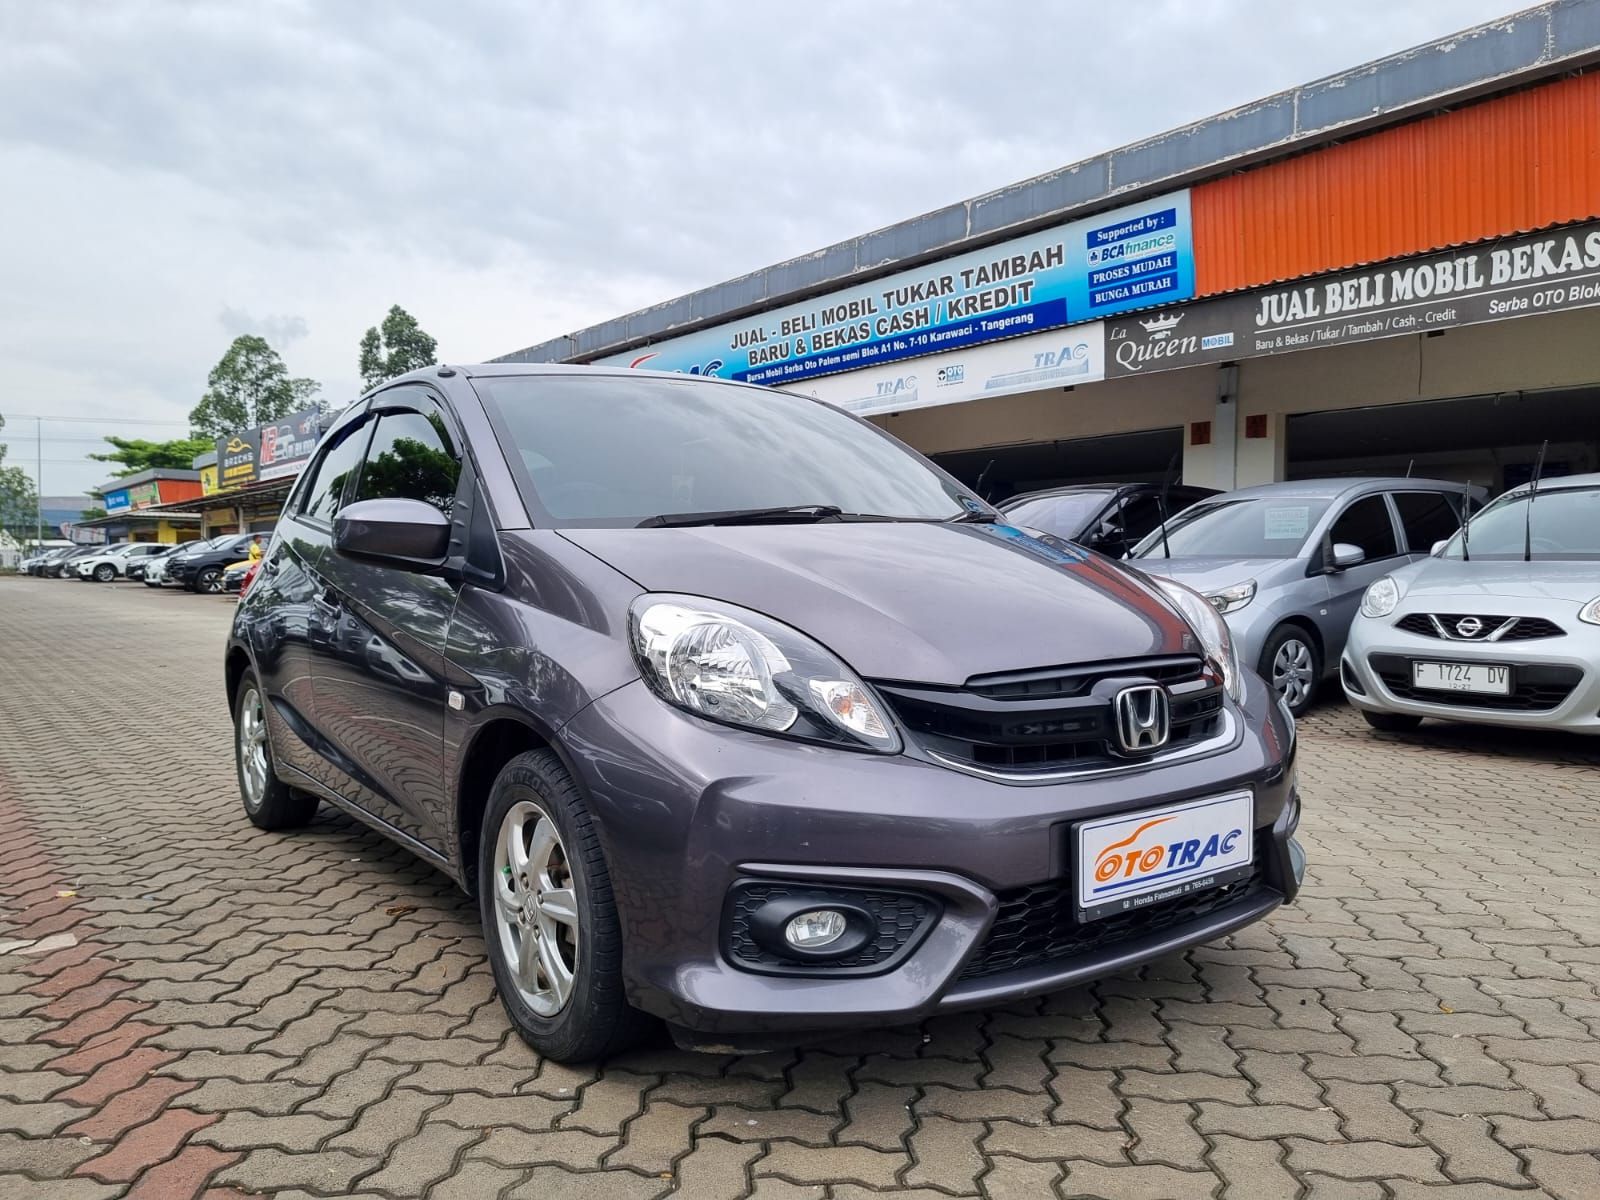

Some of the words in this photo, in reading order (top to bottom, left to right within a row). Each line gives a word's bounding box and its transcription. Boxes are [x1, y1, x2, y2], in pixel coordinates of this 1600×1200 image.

[1097, 221, 1144, 241] Supported
[1146, 216, 1158, 229] by
[1093, 266, 1130, 284] PROSES
[1132, 256, 1172, 275] MUDAH
[1255, 287, 1320, 326] JUAL
[1325, 273, 1385, 315] BELI
[1390, 255, 1484, 303] MOBIL
[1490, 231, 1600, 286] BEKAS
[731, 327, 768, 349] JUAL
[781, 313, 816, 337] BELI
[821, 298, 878, 326] MOBIL
[883, 275, 954, 309] TUKAR
[960, 244, 1064, 289] TAMBAH
[1095, 287, 1130, 304] BUNGA
[1132, 277, 1172, 296] MURAH
[1488, 297, 1529, 315] Serba
[1532, 288, 1565, 307] OTO
[749, 342, 789, 366] BARU
[795, 338, 807, 355] &
[812, 322, 870, 352] BEKAS
[876, 306, 929, 336] CASH
[935, 303, 941, 323] /
[948, 280, 1034, 320] KREDIT
[1110, 327, 1127, 341] La
[1255, 339, 1274, 351] Baru
[1275, 337, 1284, 348] &
[1285, 333, 1309, 346] Bekas
[1316, 325, 1340, 341] Tukar
[1348, 320, 1384, 335] Tambah
[1392, 313, 1416, 328] Cash
[1425, 308, 1457, 323] Credit
[765, 366, 784, 379] Mobil
[784, 362, 803, 375] Serba
[804, 358, 818, 370] Oto
[818, 355, 841, 368] Palem
[842, 352, 860, 362] semi
[861, 345, 879, 358] Blok
[881, 342, 892, 354] A1
[894, 339, 908, 350] No.
[909, 334, 928, 348] 7-10
[930, 322, 973, 345] Karawaci
[980, 313, 1034, 332] Tangerang
[1033, 343, 1089, 368] TRAC
[1115, 335, 1198, 371] Queen
[1202, 335, 1233, 348] MOBIL
[947, 365, 963, 376] OTO
[876, 375, 918, 395] TRAC
[1439, 664, 1472, 682] 1724
[1487, 666, 1506, 684] DV
[1095, 829, 1242, 882] OTOTRAC
[1134, 895, 1154, 907] Honda
